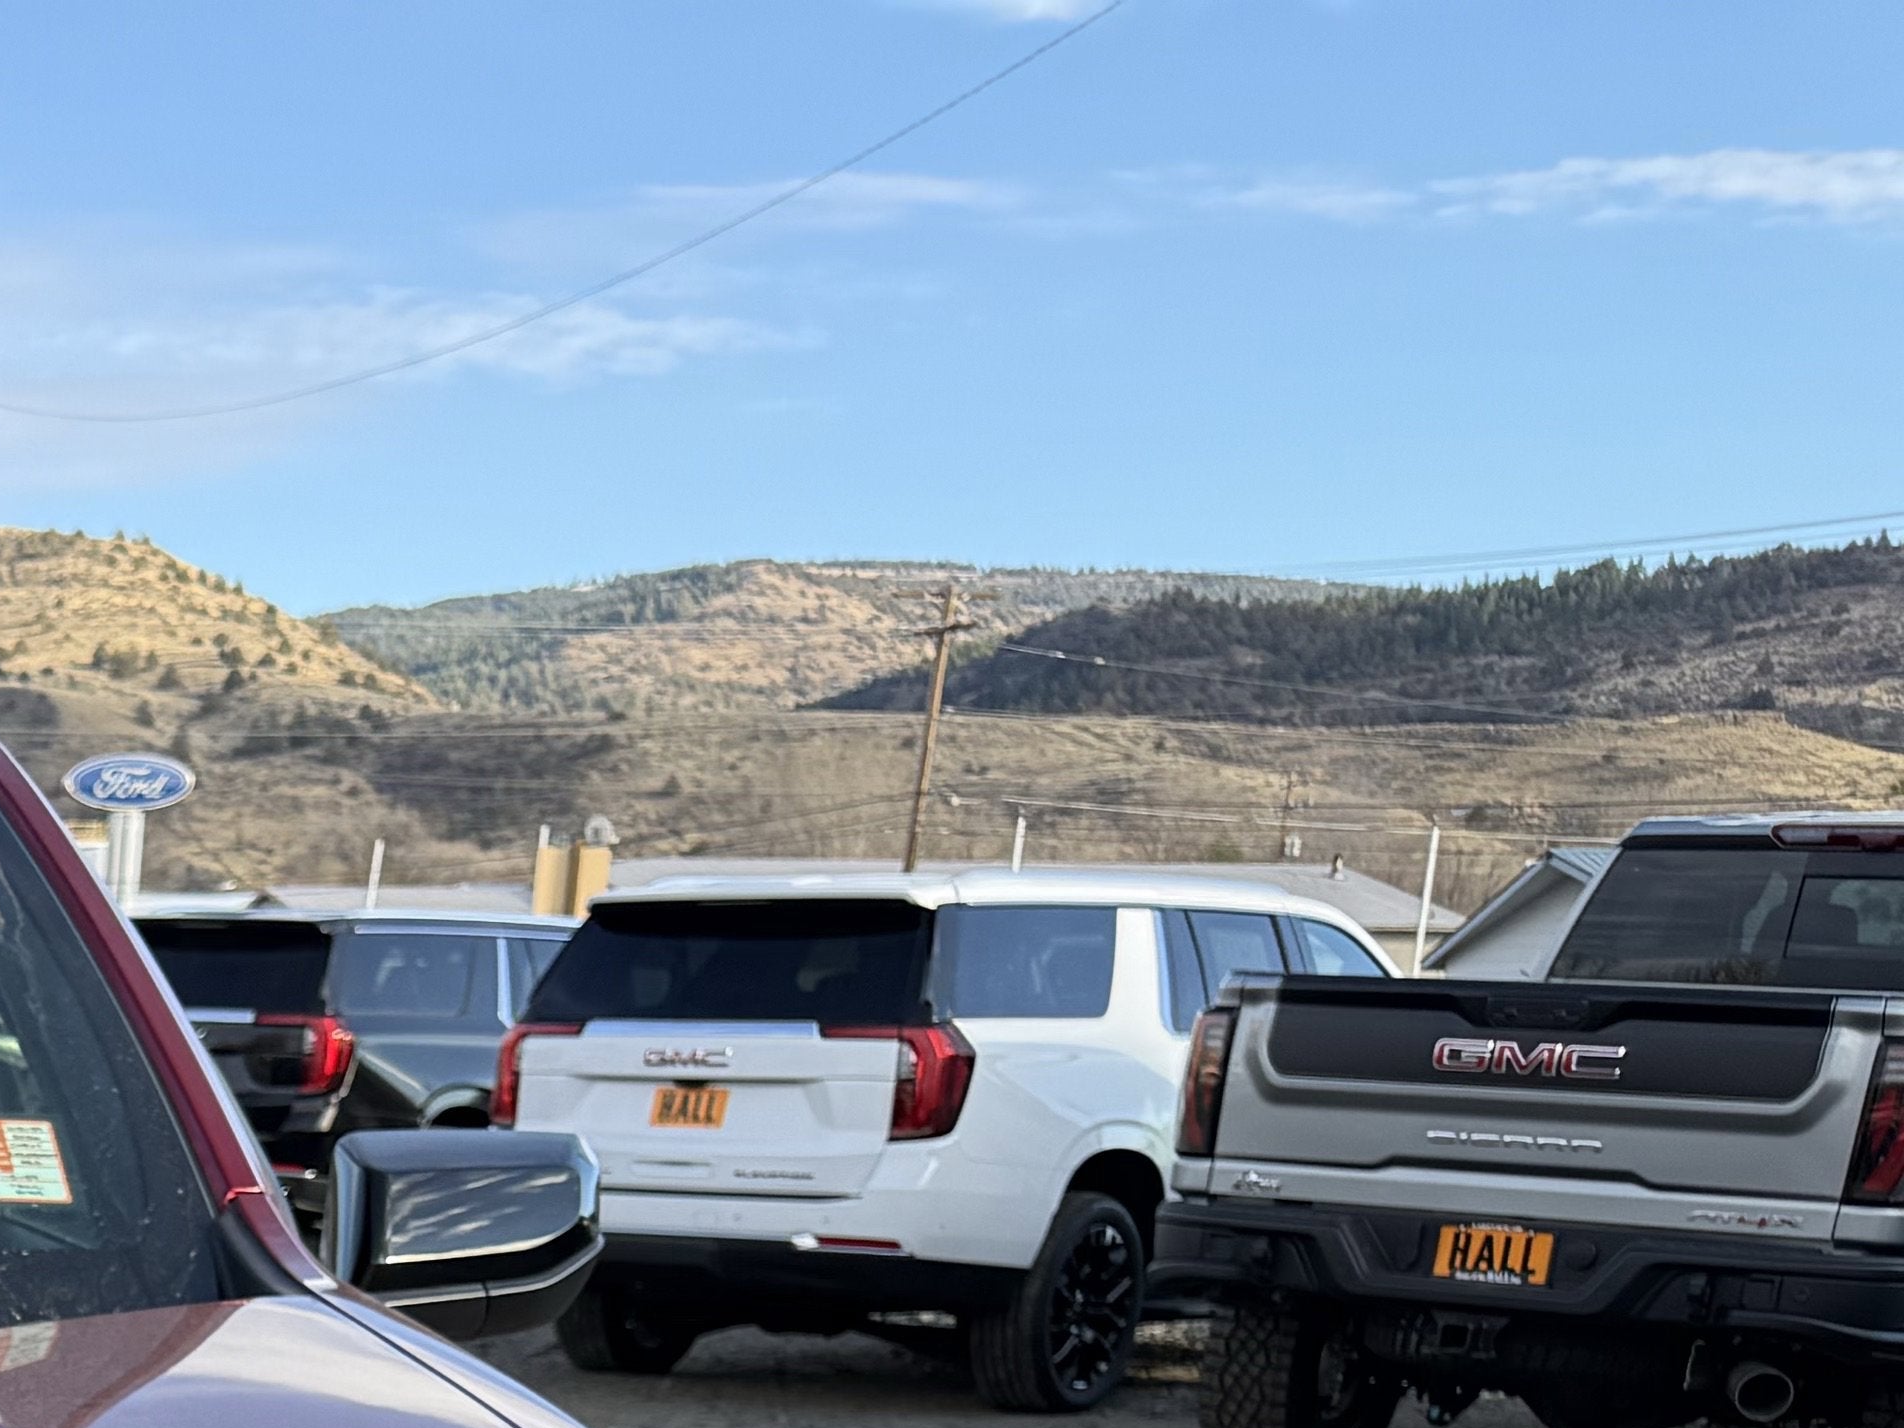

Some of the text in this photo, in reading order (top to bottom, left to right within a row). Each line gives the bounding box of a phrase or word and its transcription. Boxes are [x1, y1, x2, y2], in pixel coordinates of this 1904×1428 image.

[92, 766, 170, 799] Ford
[644, 1046, 734, 1068] GMC
[1432, 1036, 1627, 1080] GMC
[656, 1087, 718, 1126] HALL
[1448, 1231, 1536, 1275] HALL
